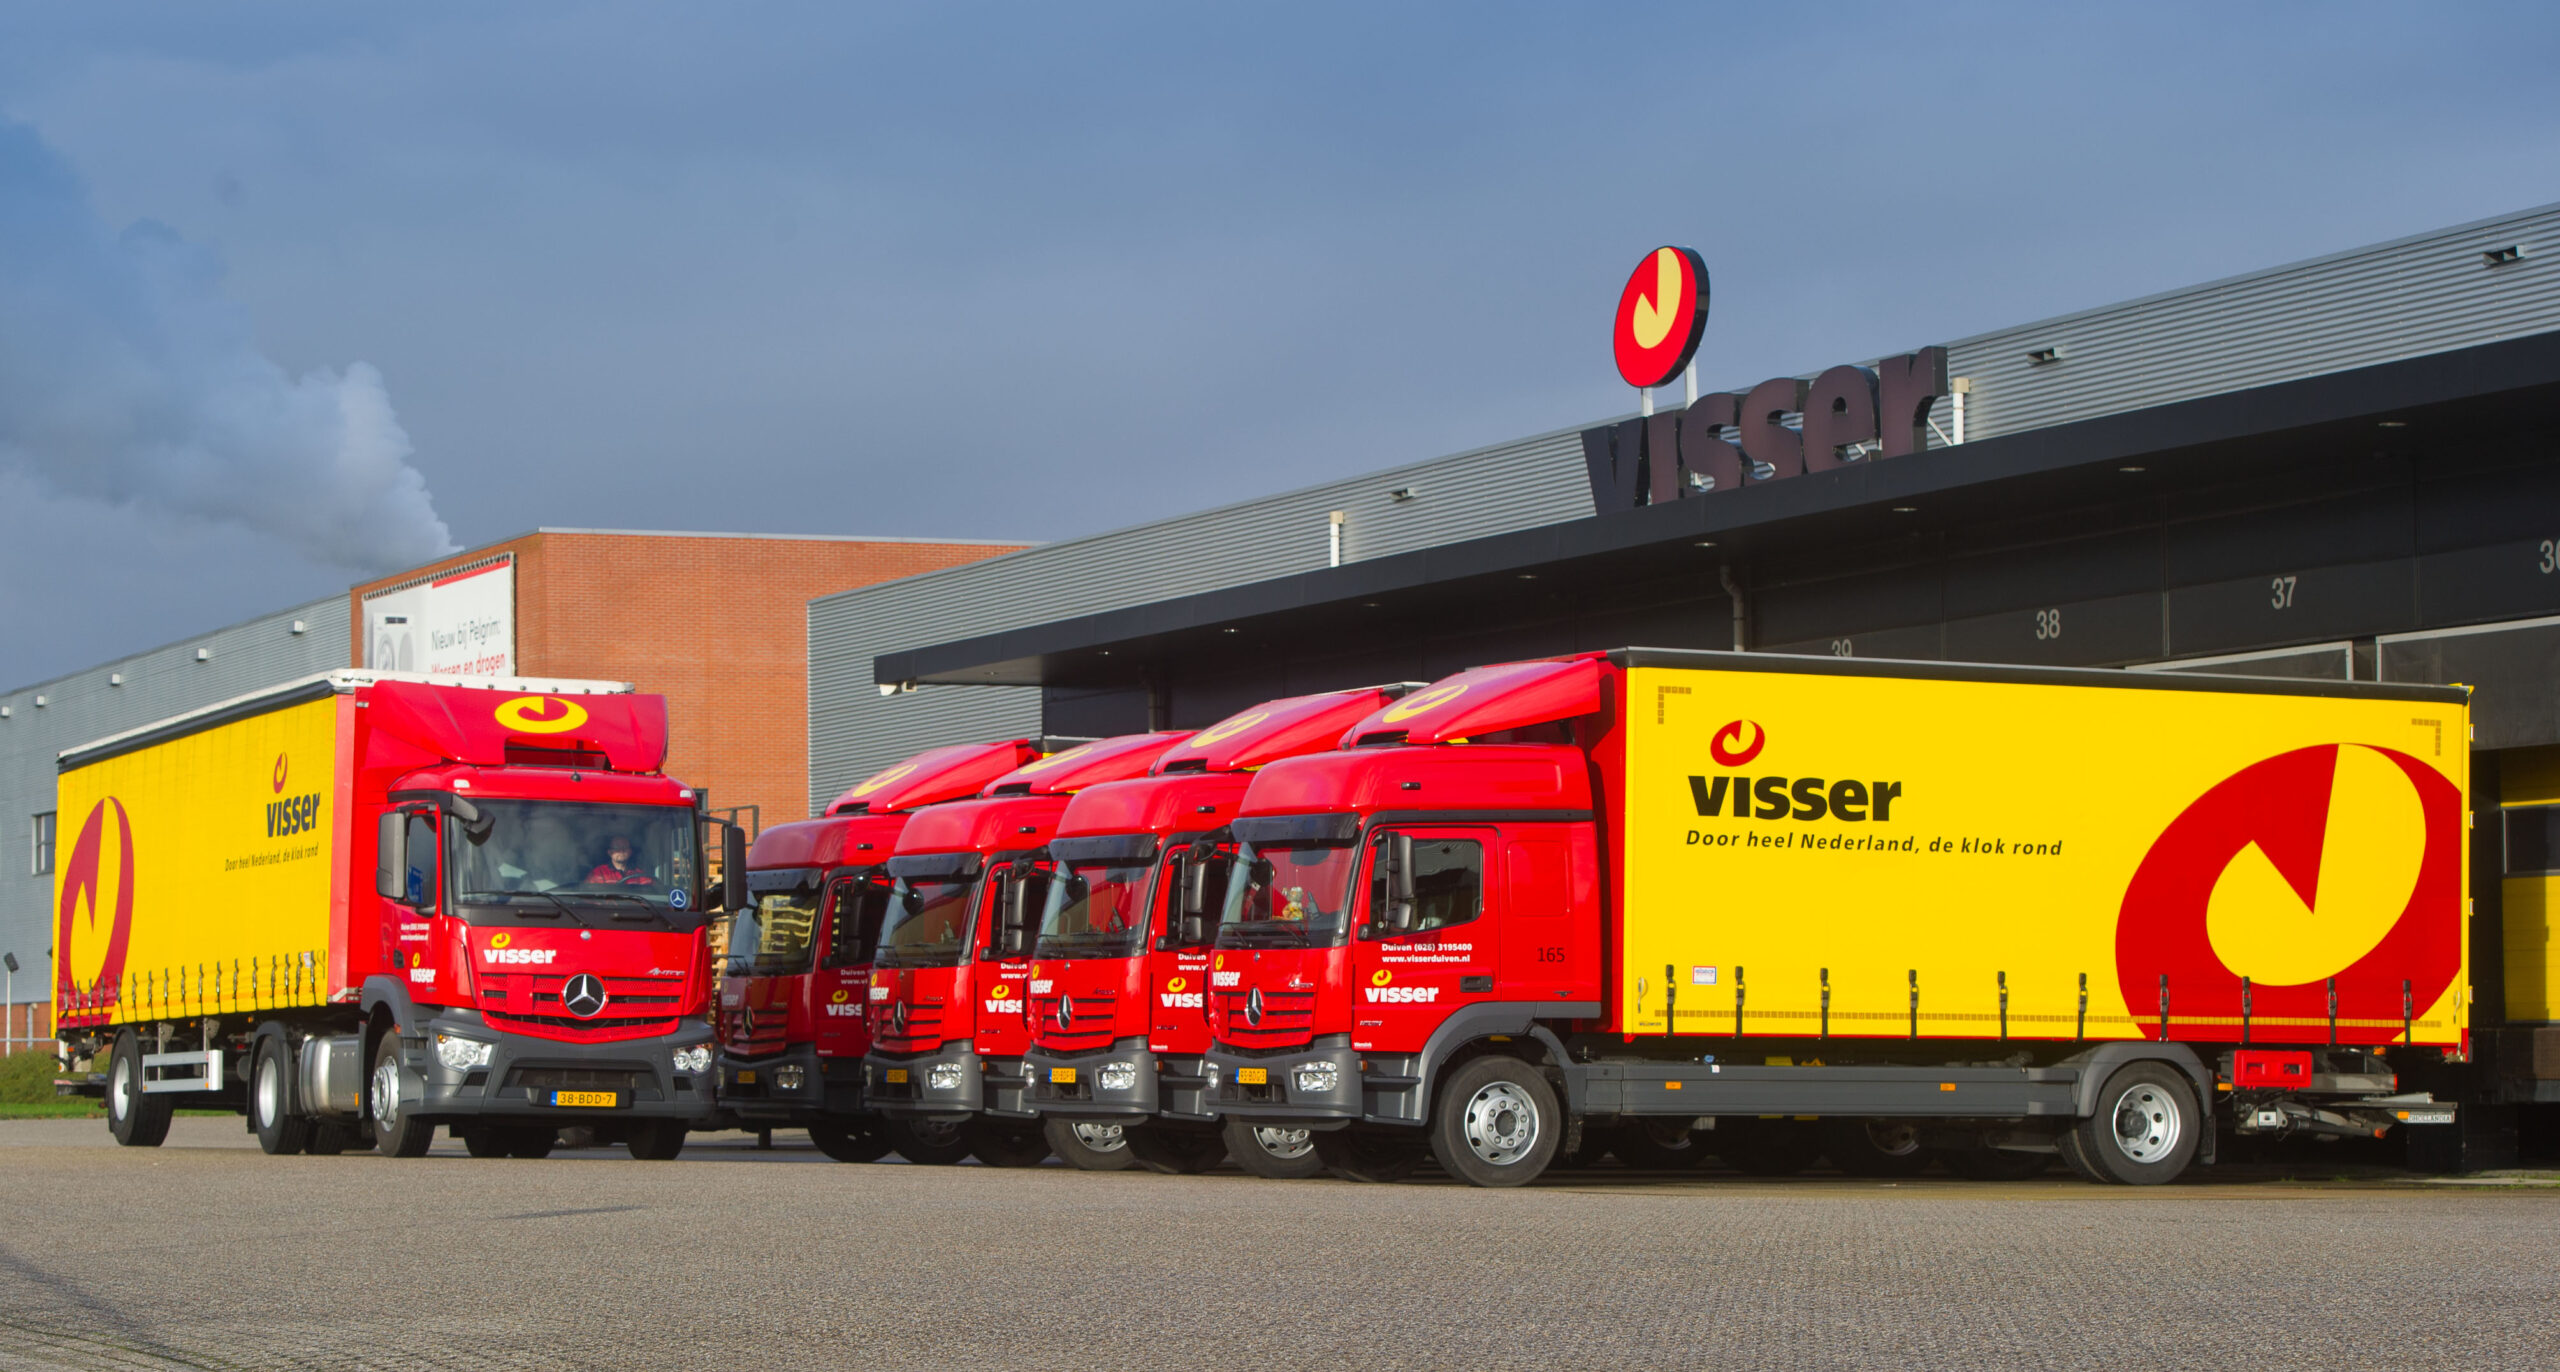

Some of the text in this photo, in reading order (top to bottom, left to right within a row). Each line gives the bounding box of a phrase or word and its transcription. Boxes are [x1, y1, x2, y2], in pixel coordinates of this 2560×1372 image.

[1581, 346, 1949, 517] visser
[2271, 576, 2297, 609] 37
[2036, 609, 2061, 640] 38
[431, 628, 455, 651] Nieuw
[1832, 638, 1853, 658] 39
[476, 651, 505, 677] drogen
[1688, 775, 1902, 822] visser
[266, 792, 320, 838] visser
[1686, 830, 2063, 857] Door heel Nederland, de klok rond
[483, 948, 557, 964] visser
[1381, 943, 1412, 951] Duiven
[1414, 943, 1436, 952] (026)
[1537, 947, 1566, 962] 165
[1000, 962, 1028, 970] Duiven
[1178, 953, 1207, 961] Duiven
[1382, 954, 1471, 963] www.visserduiven.nl
[410, 968, 436, 983] visser
[1212, 971, 1241, 987] visser
[1364, 986, 1439, 1003] visser
